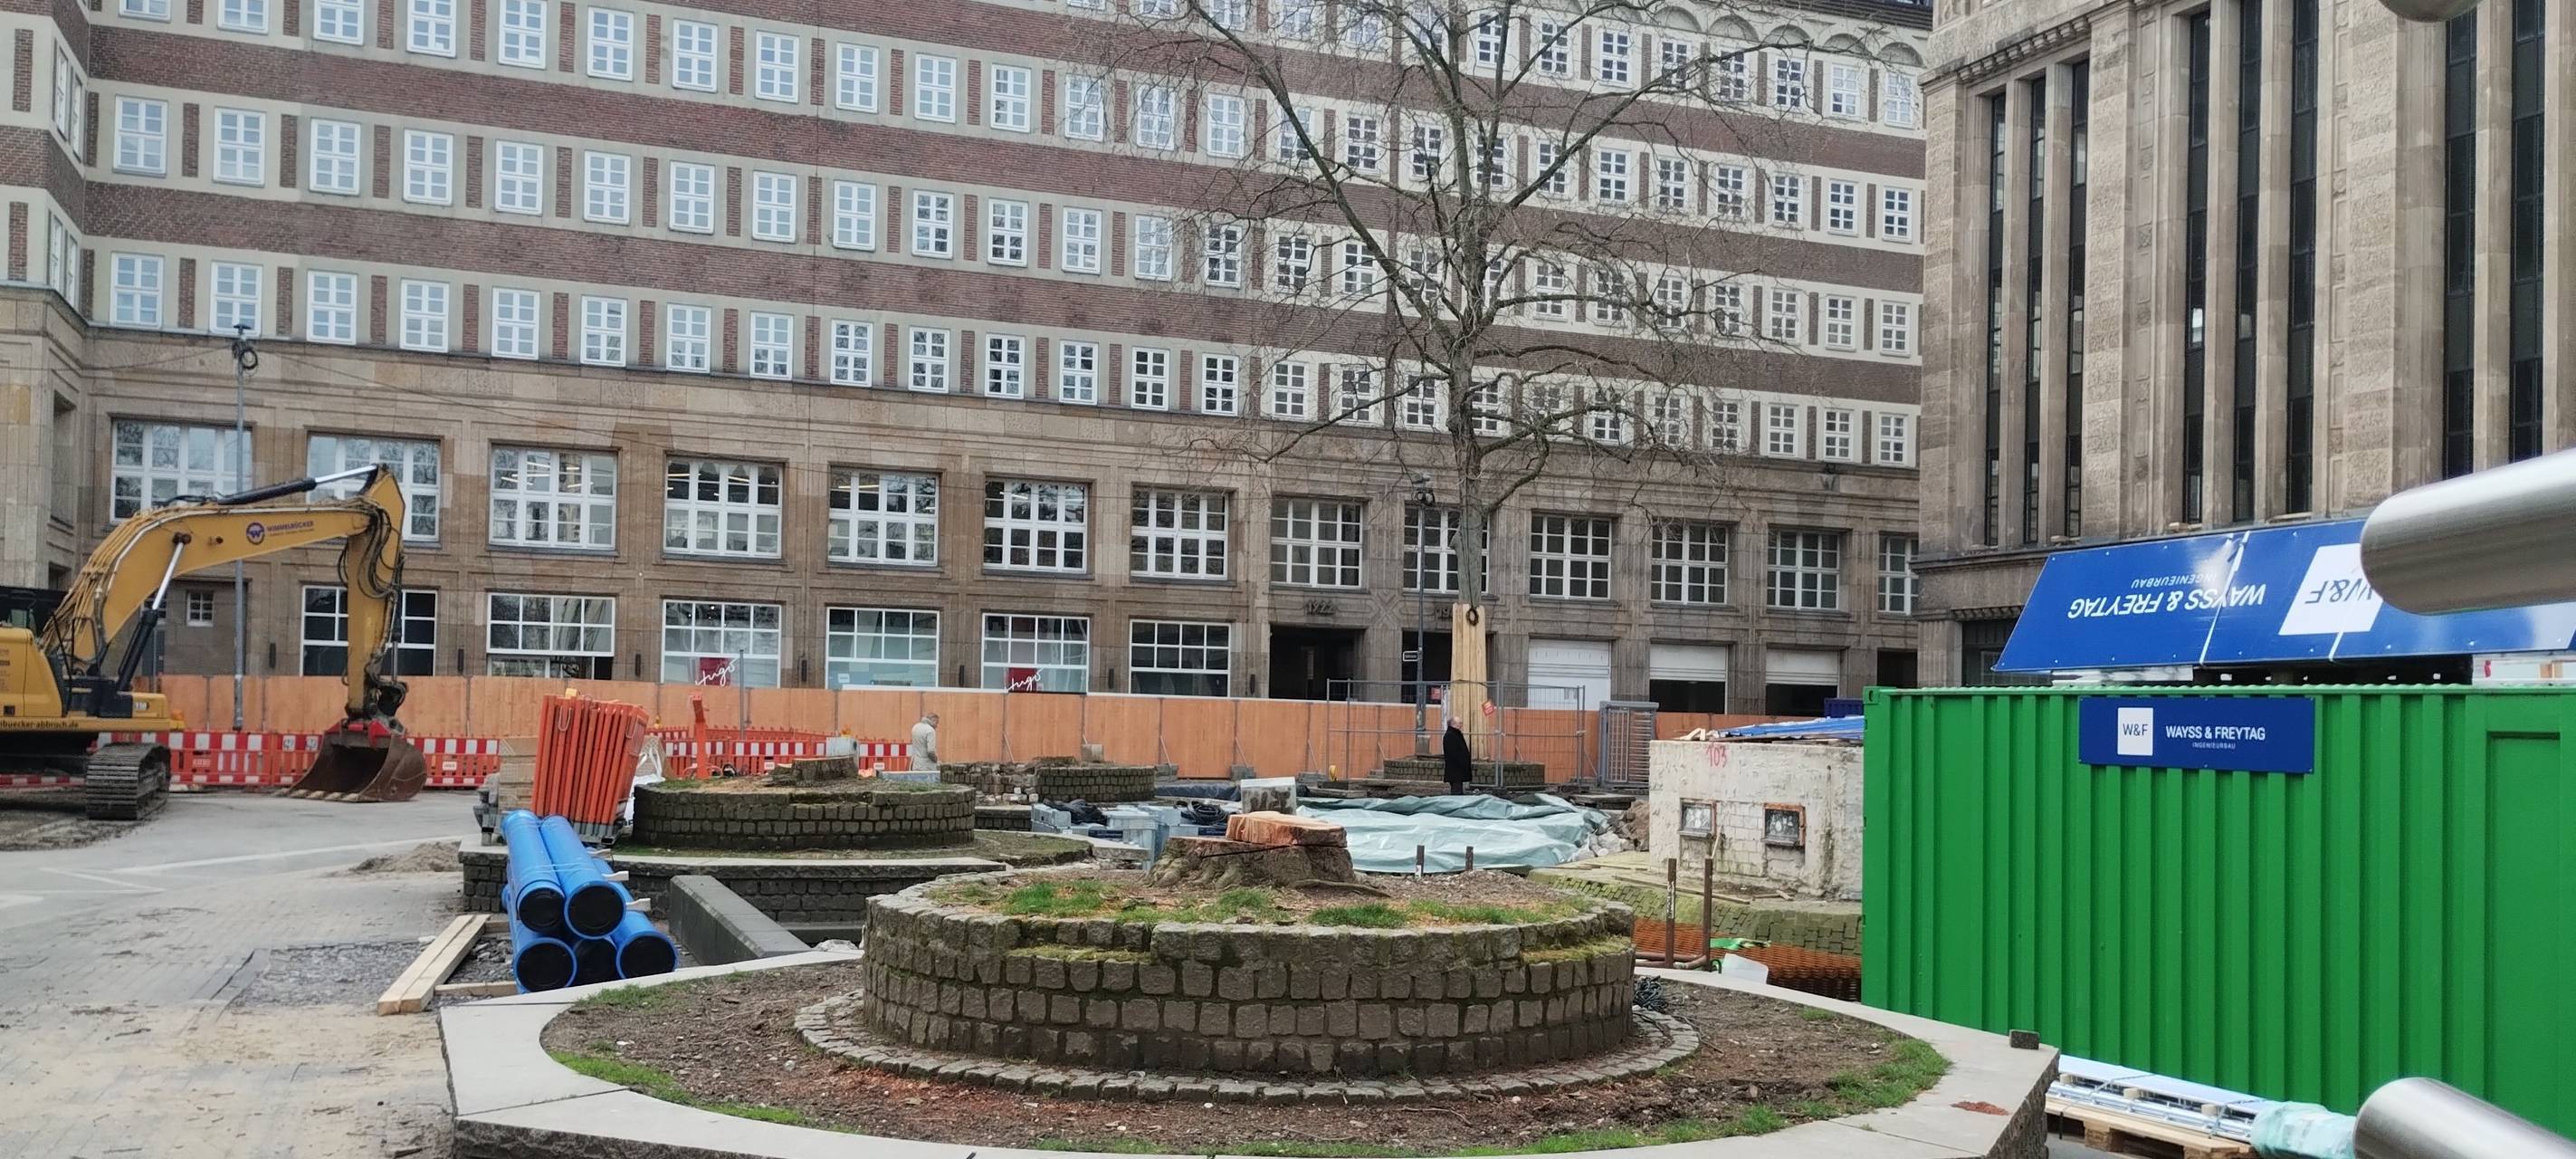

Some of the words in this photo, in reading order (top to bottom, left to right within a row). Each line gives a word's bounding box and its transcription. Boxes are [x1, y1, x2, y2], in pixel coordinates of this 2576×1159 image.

[2131, 572, 2218, 589] INGENIEURBAU
[2184, 583, 2266, 610] WAYSS
[2305, 577, 2373, 604] W&F
[2067, 591, 2164, 619] FREYTAG
[2166, 590, 2183, 612] &
[2123, 723, 2148, 736] W&F
[2166, 725, 2202, 739] WAYSS
[2204, 725, 2213, 740] &
[2215, 726, 2266, 742] FREYTAG
[2192, 742, 2236, 750] INGENIEURBAU
